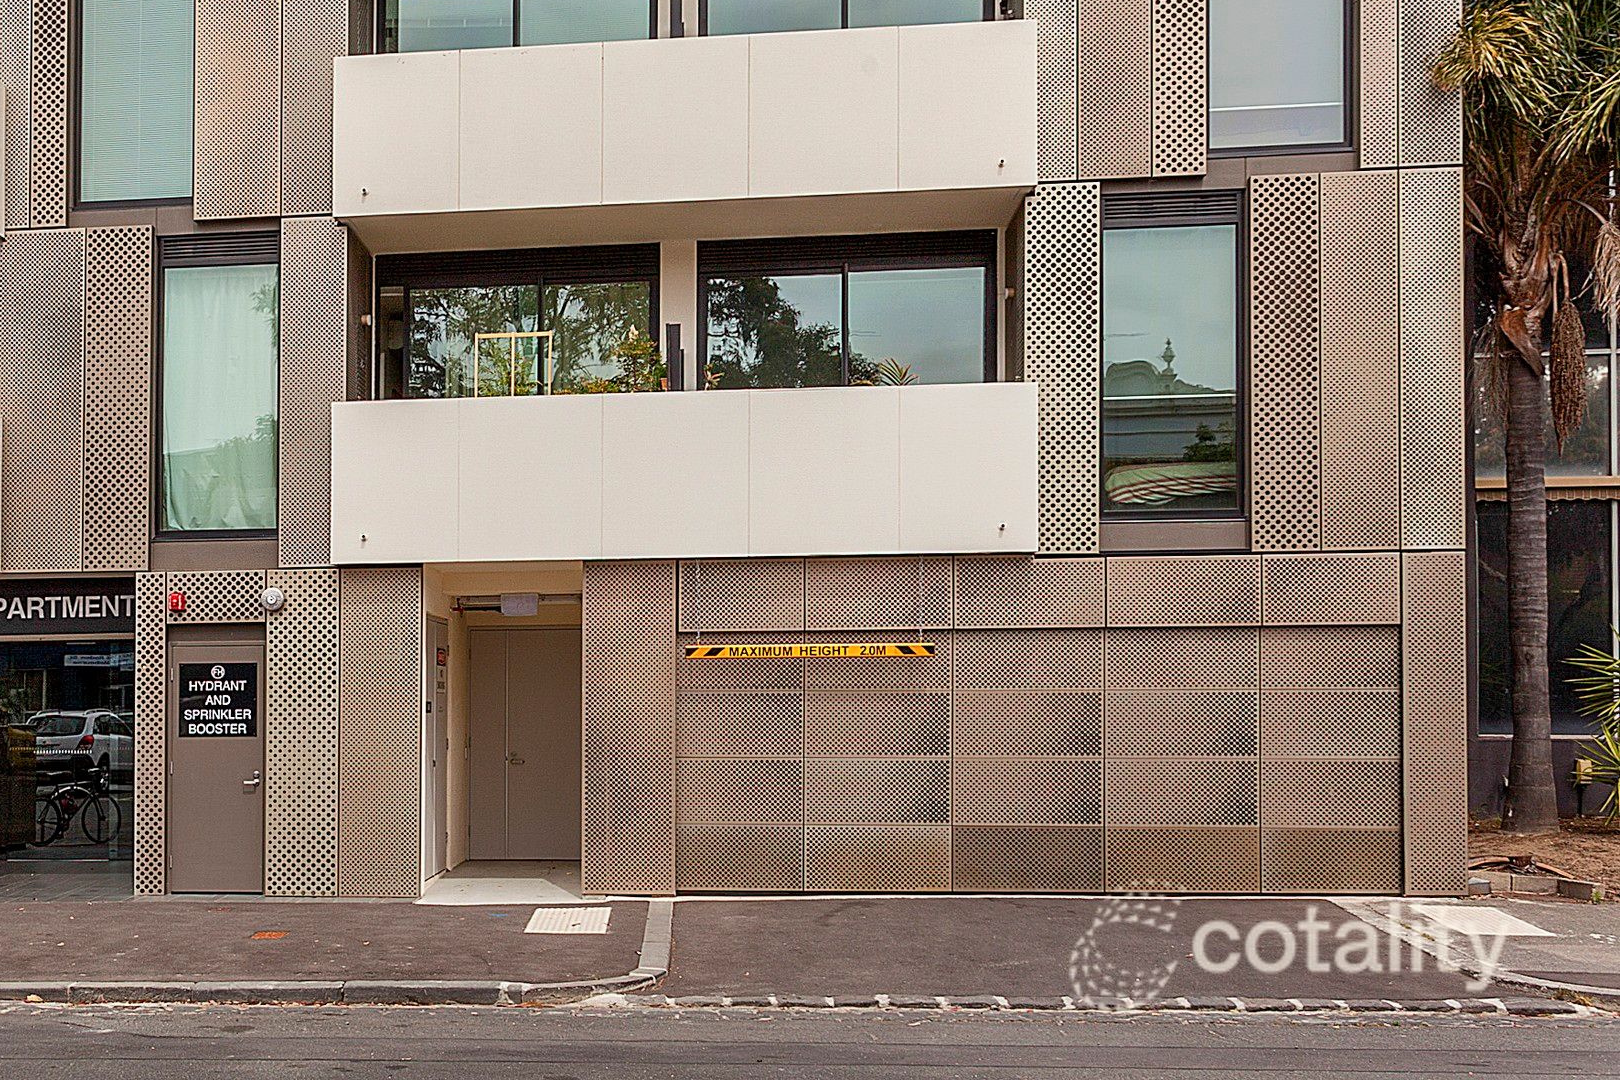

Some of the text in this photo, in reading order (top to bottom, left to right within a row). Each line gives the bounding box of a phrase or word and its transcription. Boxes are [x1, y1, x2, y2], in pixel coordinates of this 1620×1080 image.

[730, 645, 887, 657] MAXIMUM HEIGHT 2.0M
[188, 680, 247, 691] HYDRANT
[205, 695, 231, 706] AND
[184, 709, 252, 720] SPRINKLER
[188, 723, 247, 734] BOOSTER
